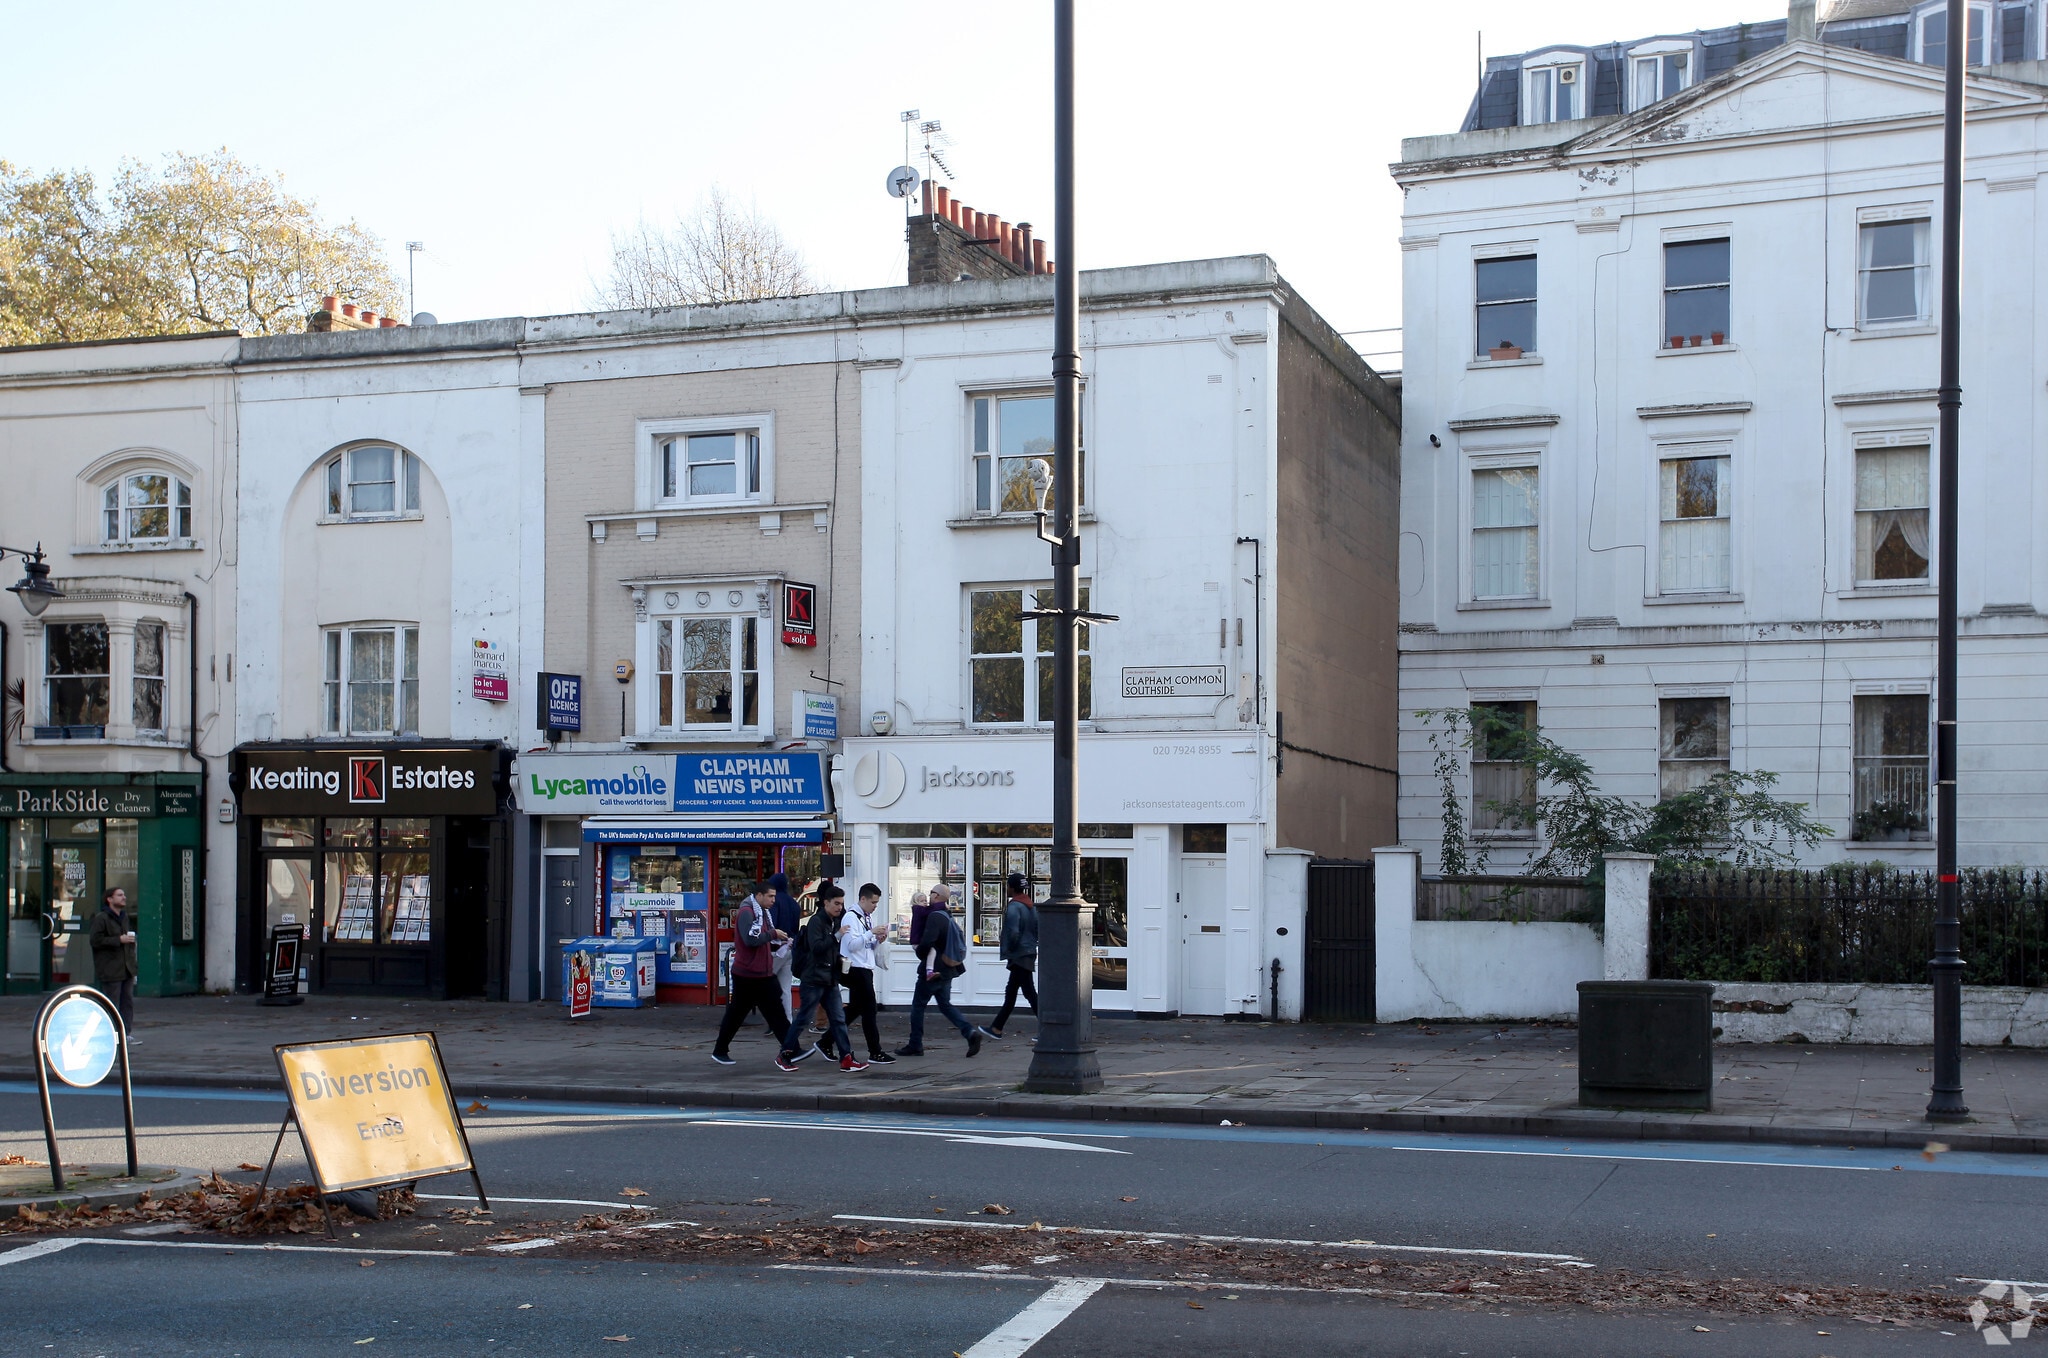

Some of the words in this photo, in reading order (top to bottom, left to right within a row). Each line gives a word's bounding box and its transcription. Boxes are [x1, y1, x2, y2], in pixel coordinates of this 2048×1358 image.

[788, 588, 810, 620] K
[791, 634, 806, 644] sold
[474, 648, 504, 662] barnard
[474, 660, 502, 670] marcus
[474, 678, 482, 686] to
[483, 679, 493, 688] let
[1126, 676, 1172, 686] CLAPHAM
[1174, 675, 1222, 685] COMMON
[551, 678, 578, 700] OFF
[1126, 686, 1174, 696] SOUTHSIDE
[550, 700, 578, 712] LICENCE
[807, 698, 834, 710] Lycamobile
[550, 714, 562, 724] Open
[806, 726, 816, 734] OFF
[816, 727, 835, 736] LICENCE
[1153, 746, 1170, 756] 020
[1174, 746, 1196, 755] 7924
[1198, 746, 1222, 754] 8955
[700, 758, 790, 776] CLAPHAM
[250, 766, 340, 796] Keating
[353, 760, 382, 799] K
[392, 765, 476, 790] Estates
[920, 765, 1015, 792] Jacksons
[531, 773, 667, 800] Lycamobile
[694, 778, 746, 794] NEWS
[751, 778, 805, 794] POINT
[17, 788, 110, 812] ParkSide
[124, 792, 141, 802] Dry
[115, 802, 151, 812] Cleaners
[166, 805, 188, 814] Repairs
[1122, 799, 1246, 810] jacksonsestateagents.com
[639, 832, 647, 840] Pay
[116, 848, 128, 857] 020
[629, 897, 676, 907] Lycamobile
[300, 1063, 431, 1102] Diversion
[356, 1119, 404, 1140] Ends
